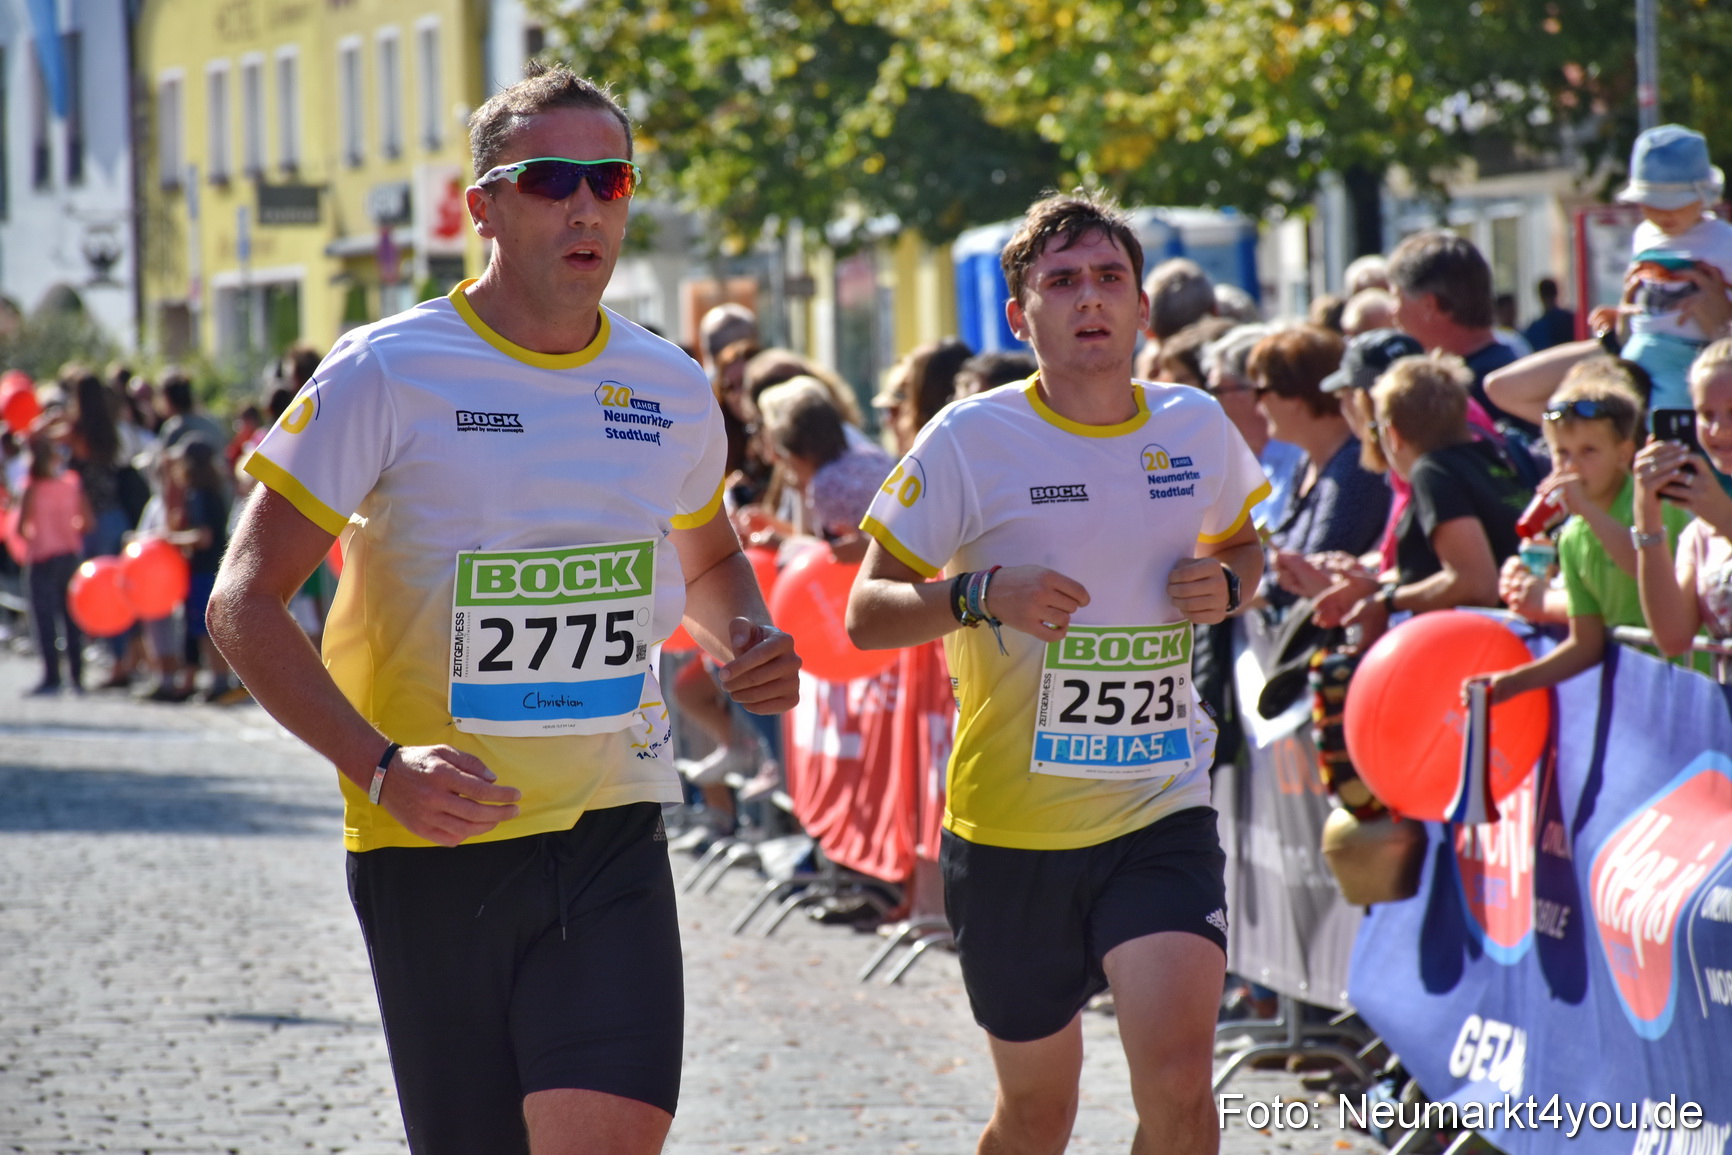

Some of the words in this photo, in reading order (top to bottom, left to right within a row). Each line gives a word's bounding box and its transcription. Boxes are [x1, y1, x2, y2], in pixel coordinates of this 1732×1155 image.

[601, 385, 630, 408] 20
[456, 410, 523, 428] BOCK
[603, 409, 673, 429] Neumarkter
[605, 427, 661, 447] Stadtlauf
[1143, 451, 1169, 471] 20
[881, 464, 922, 508] 20
[1147, 470, 1200, 485] Neumarkter
[1030, 484, 1088, 500] BOCK
[1149, 484, 1195, 499] Stadtlauf
[471, 549, 642, 599] BOCK
[478, 610, 635, 672] 2775
[1058, 627, 1186, 666] BOCK
[522, 692, 583, 709] Christian
[1059, 676, 1175, 726] 2523
[1042, 733, 1164, 763] TOBIAS
